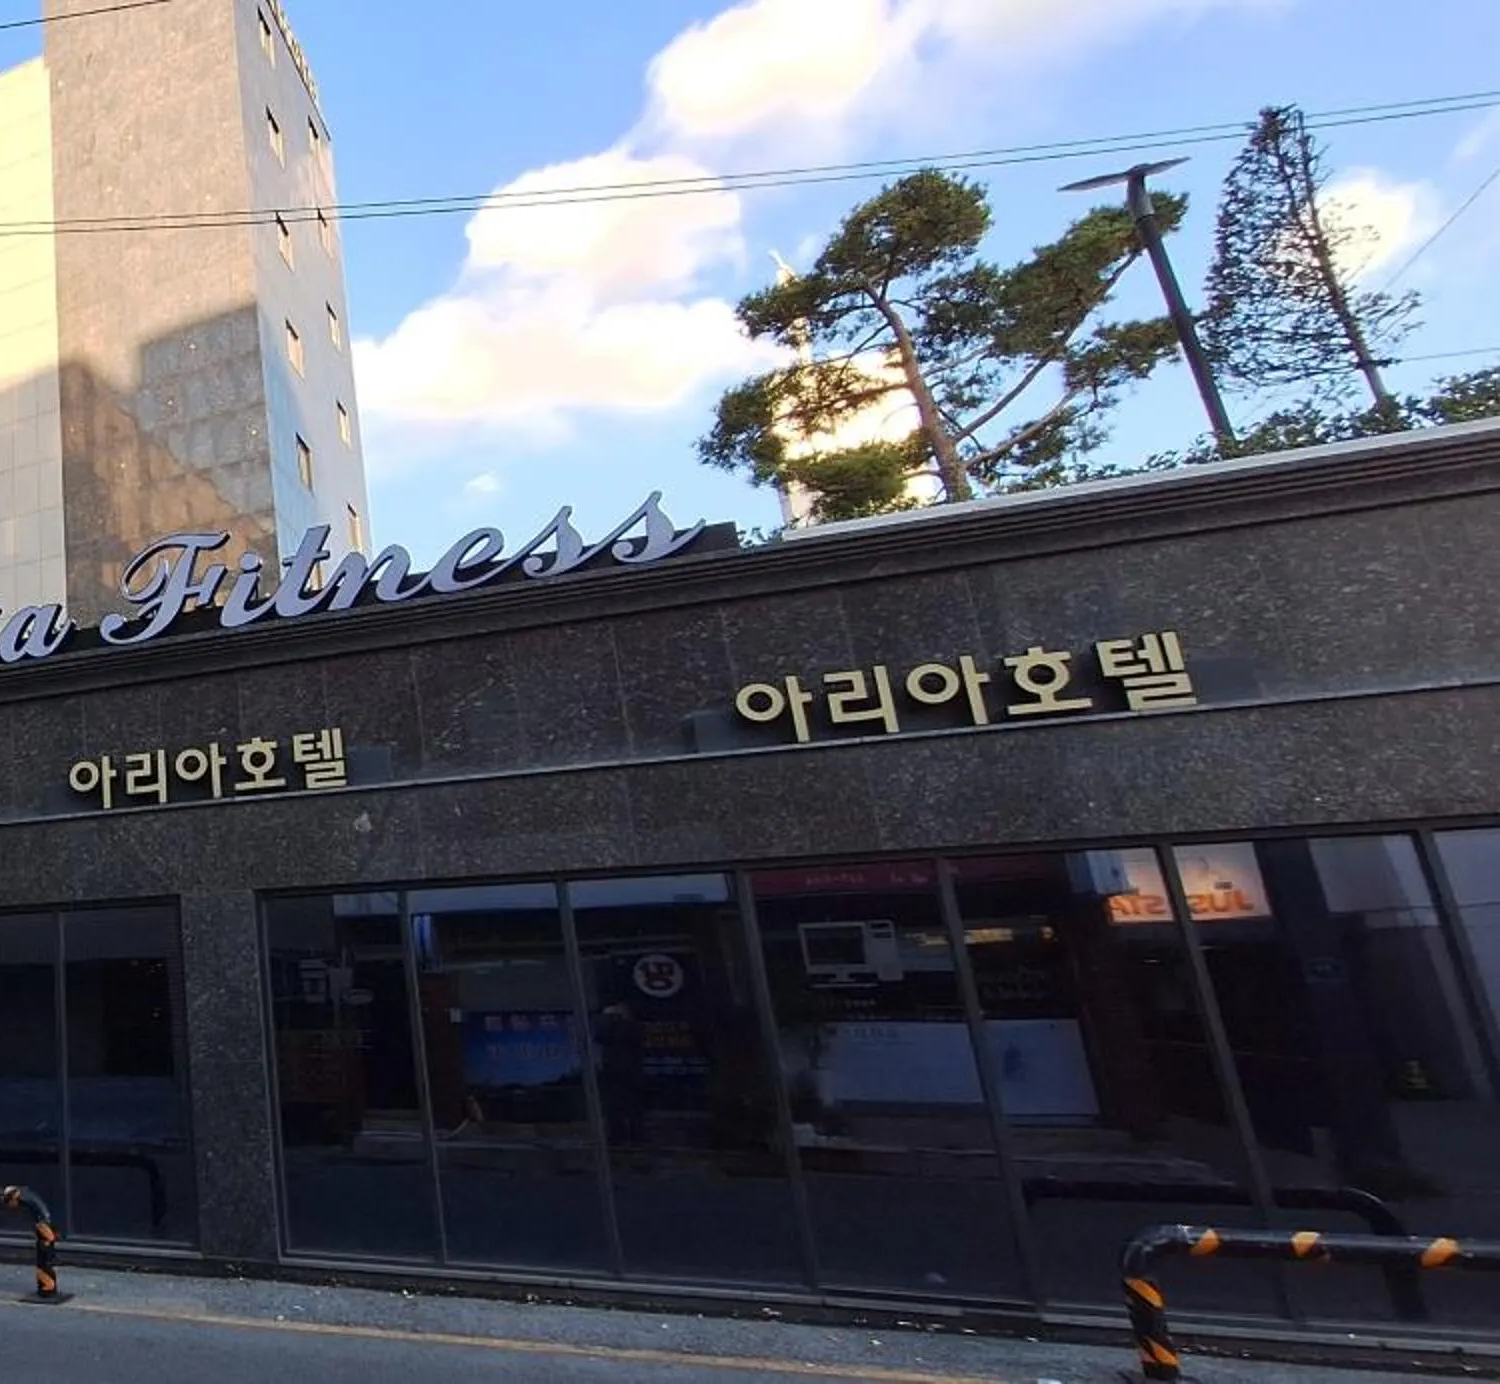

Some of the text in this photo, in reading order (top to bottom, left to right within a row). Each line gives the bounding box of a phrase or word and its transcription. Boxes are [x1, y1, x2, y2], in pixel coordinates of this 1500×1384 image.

[100, 491, 705, 645] Fitness
[735, 631, 1198, 742] 아리아호텔
[69, 728, 348, 808] 아리아호텔
